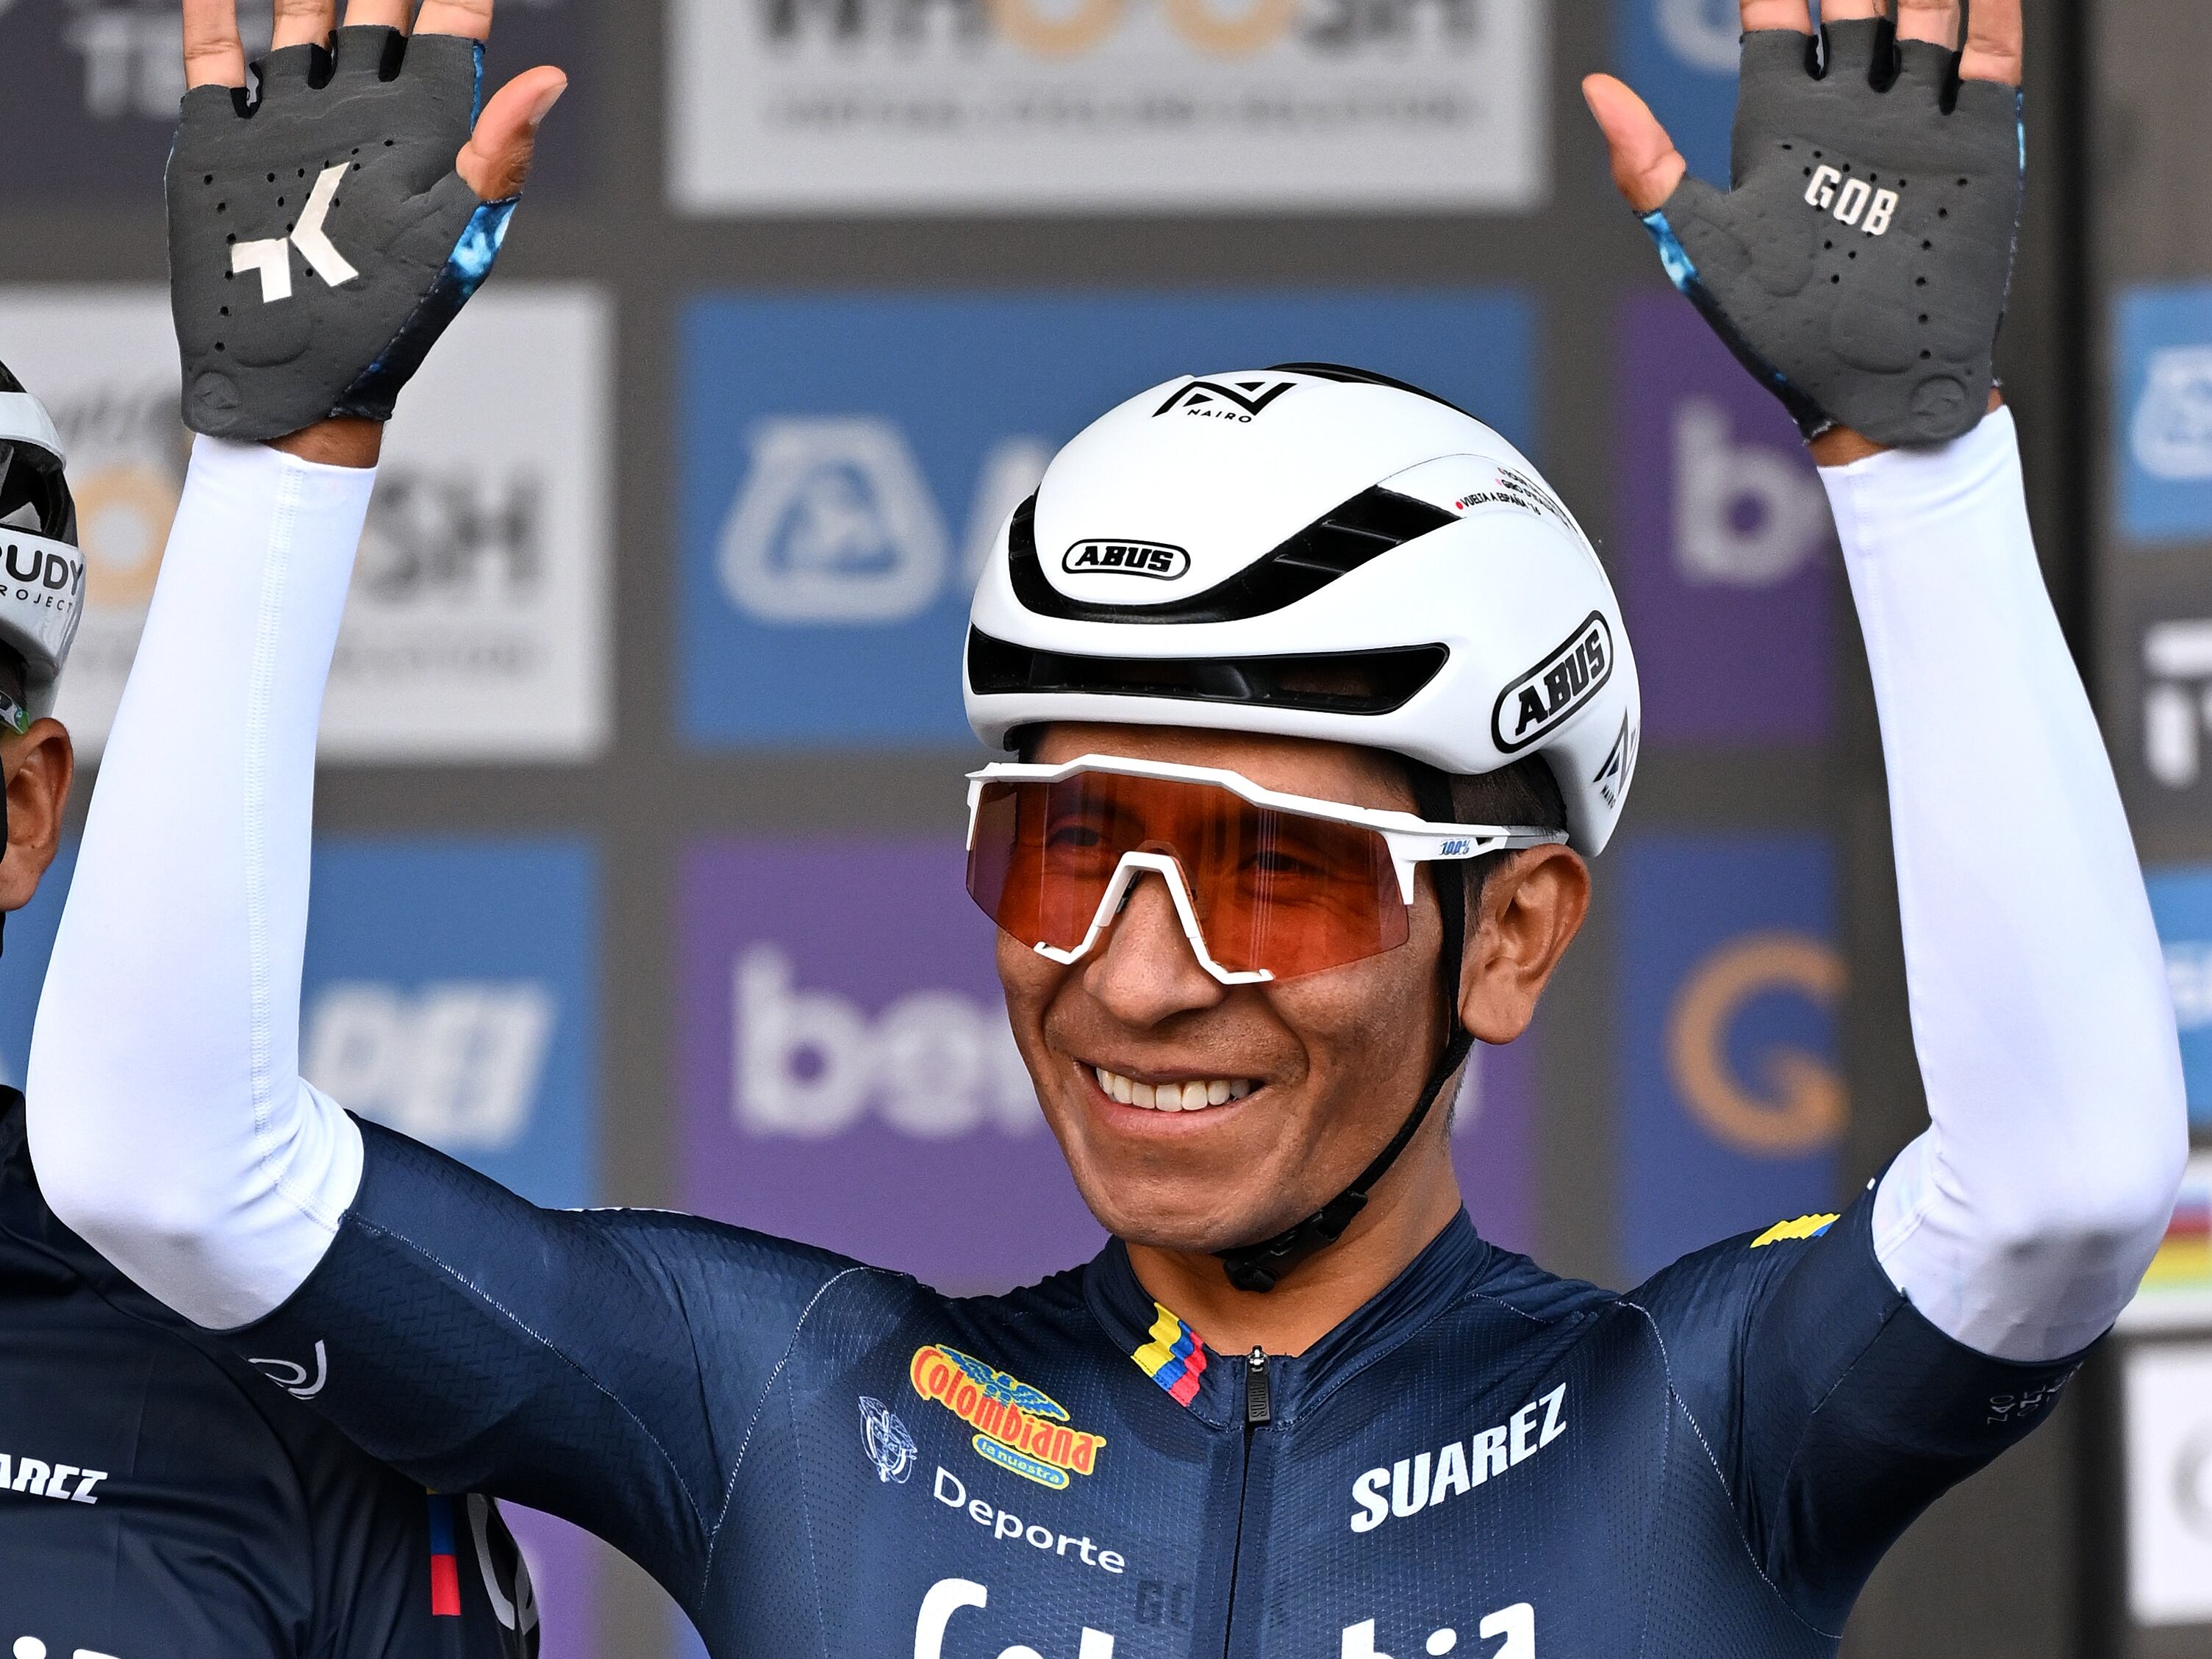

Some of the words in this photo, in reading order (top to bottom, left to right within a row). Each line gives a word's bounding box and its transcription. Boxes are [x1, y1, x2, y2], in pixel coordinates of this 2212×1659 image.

[1805, 164, 1900, 235] GOB
[1186, 409, 1252, 423] NAIRO
[1460, 492, 1490, 507] VUELTA
[0, 544, 84, 596] UDY
[1074, 545, 1174, 573] ABUS
[0, 584, 74, 613] ROJECT
[1514, 628, 1605, 737] ABUS
[1439, 839, 1470, 856] 100%
[914, 1347, 1095, 1473] Colombiana
[998, 1450, 1060, 1483] nuestra
[1350, 1382, 1567, 1533] SUAREZ
[933, 1466, 1126, 1574] Deporte
